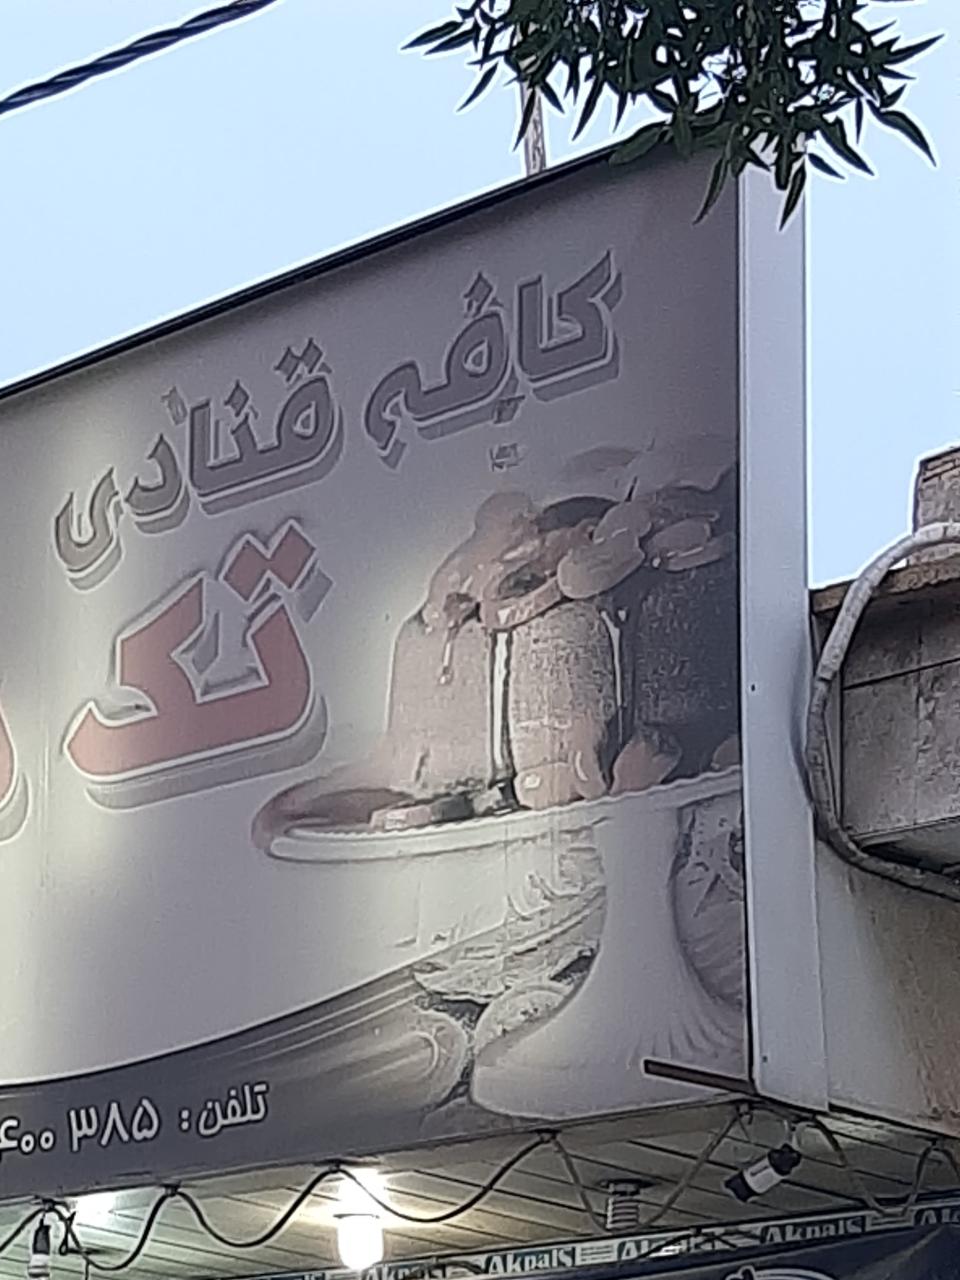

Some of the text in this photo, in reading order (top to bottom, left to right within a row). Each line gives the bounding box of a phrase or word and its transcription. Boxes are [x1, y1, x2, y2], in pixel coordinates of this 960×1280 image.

[53, 250, 622, 591] کافه قنادی
[63, 518, 330, 800] تک
[69, 1099, 160, 1152] ۳۸۵
